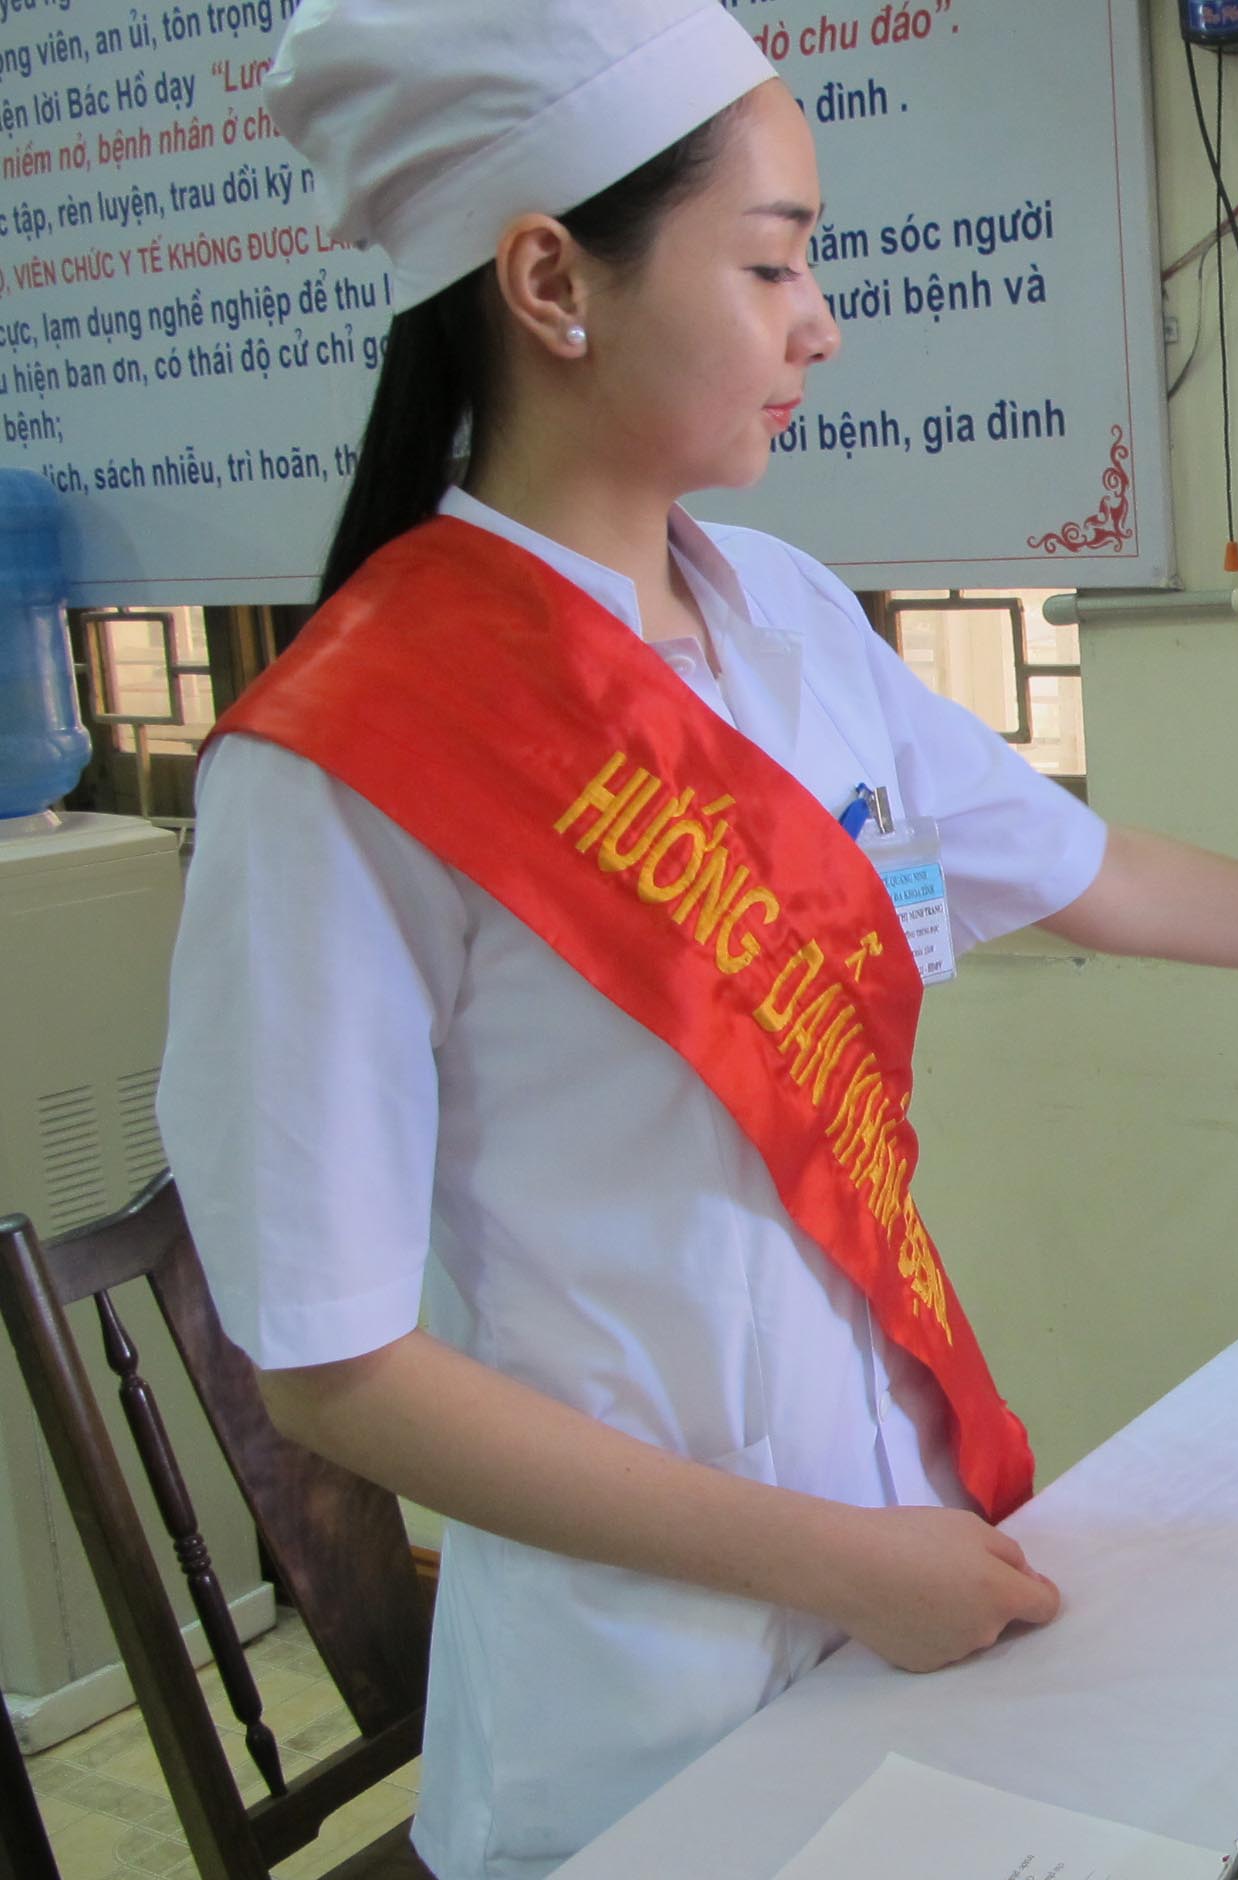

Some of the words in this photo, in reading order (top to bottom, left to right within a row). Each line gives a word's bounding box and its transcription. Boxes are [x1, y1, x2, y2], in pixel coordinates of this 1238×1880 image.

[37, 30, 89, 63] viên,
[96, 28, 122, 55] an
[129, 9, 157, 50] ủi,
[163, 6, 200, 42] tôn
[208, 0, 273, 37] trọng
[800, 15, 858, 56] chu
[33, 91, 61, 125] lời
[67, 84, 110, 119] Bác
[116, 69, 148, 111] Hồ
[155, 71, 196, 111] dạy
[816, 78, 888, 123] đình
[59, 131, 91, 173] nở,
[99, 126, 152, 172] bệnh
[159, 115, 215, 156] nhân
[222, 106, 239, 145] ở
[13, 201, 53, 242] tập,
[58, 194, 93, 228] rèn
[99, 186, 165, 228] luyện,
[170, 182, 215, 212] trau
[222, 163, 259, 204] dồi
[265, 163, 294, 206] kỹ
[880, 214, 941, 254] sóc
[953, 201, 1054, 256] người
[14, 255, 57, 291] VIÊN
[61, 246, 115, 285] CHỨC
[120, 250, 134, 277] Y
[137, 235, 164, 273] TẾ
[168, 235, 244, 272] KHÔNG
[248, 226, 310, 264] ĐƯỢC
[42, 312, 81, 350] lạm
[88, 306, 143, 345] dụng
[149, 288, 204, 338] nghề
[210, 285, 292, 332] nghiệp
[299, 268, 328, 315] để
[334, 276, 376, 312] thu
[904, 270, 992, 323] bệnh
[1003, 264, 1047, 305] và
[13, 363, 61, 400] hiện
[64, 358, 107, 389] ban
[113, 356, 149, 388] ơn,
[155, 346, 183, 380] có
[189, 343, 234, 378] thái
[241, 337, 271, 380] độ
[279, 327, 310, 368] cử
[316, 322, 355, 366] chỉ
[3, 409, 64, 449] bệnh;
[817, 409, 911, 460] bệnh,
[922, 405, 976, 454] gia
[987, 400, 1066, 441] đình
[94, 457, 145, 491] sách
[152, 445, 222, 487] nhiễu,
[227, 449, 253, 484] trì
[260, 446, 328, 482] hoãn,
[552, 750, 781, 977] HƯỚNG
